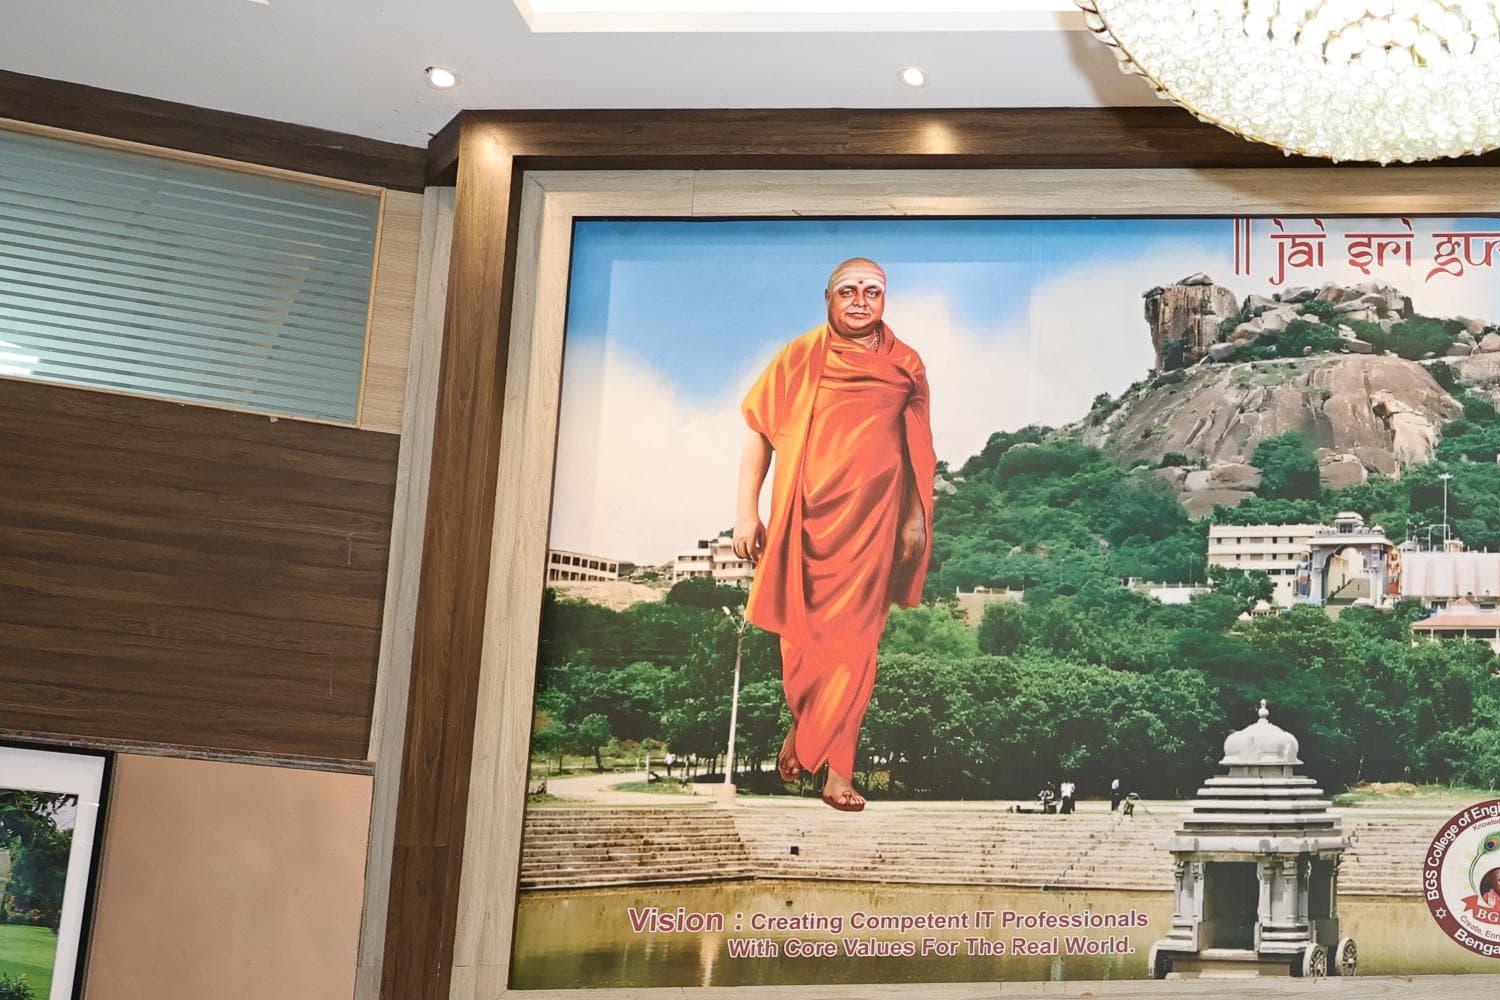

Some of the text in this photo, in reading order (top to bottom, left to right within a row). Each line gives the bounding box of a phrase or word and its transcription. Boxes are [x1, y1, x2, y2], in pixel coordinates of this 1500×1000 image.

[1269, 217, 1327, 285] jai
[1344, 217, 1414, 275] sri
[1459, 812, 1471, 827] of
[1428, 825, 1459, 867] College
[1426, 871, 1440, 900] BGS
[628, 907, 1150, 934] Vision : Creating Competent IT Professionals
[728, 934, 1137, 958] With Core Values For The Real World.
